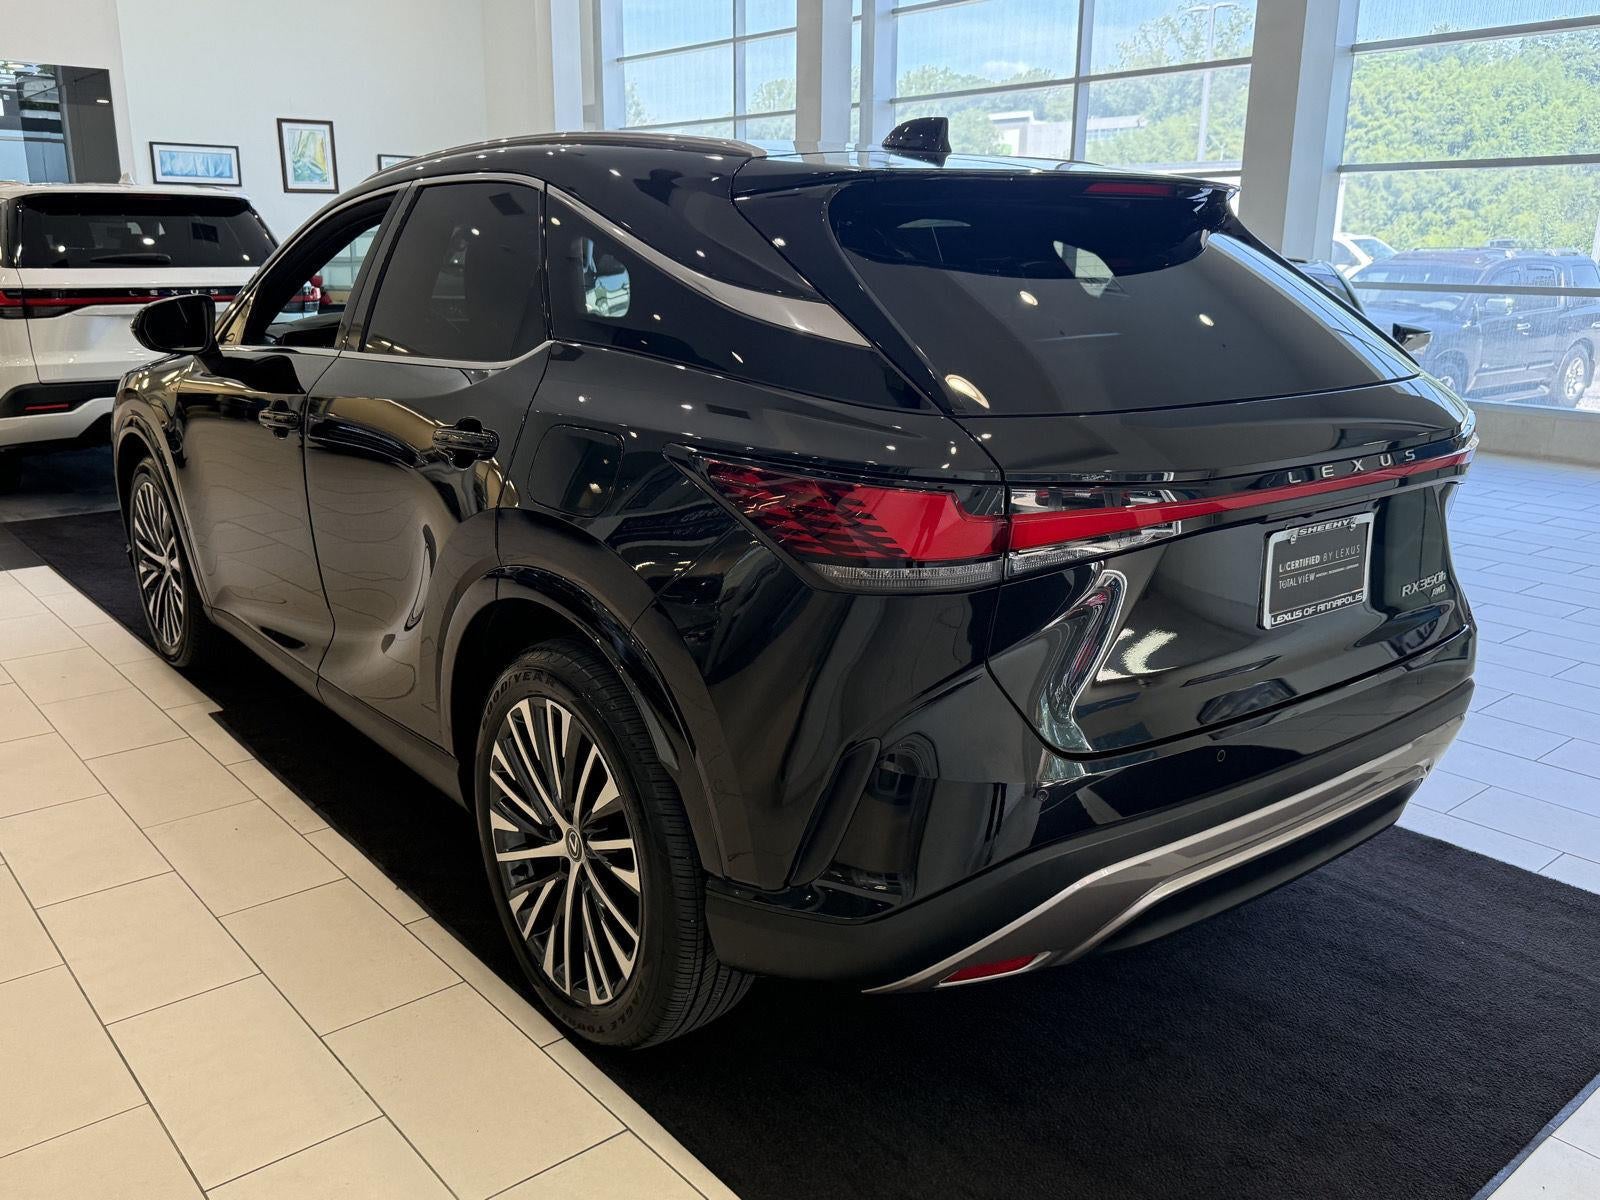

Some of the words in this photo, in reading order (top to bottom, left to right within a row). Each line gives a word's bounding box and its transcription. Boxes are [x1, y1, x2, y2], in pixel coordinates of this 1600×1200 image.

[128, 288, 219, 297] LEXUS
[1288, 449, 1416, 484] LEXUS
[1298, 519, 1351, 536] SHEEHY
[1323, 551, 1334, 562] BY
[1335, 544, 1361, 560] LEXUS
[1279, 577, 1298, 590] TOTAL
[1298, 572, 1317, 585] VIEW
[1431, 584, 1446, 597] AWD
[1271, 609, 1303, 625] LEXUS
[1303, 606, 1317, 617] OF
[1317, 592, 1364, 613] ANNAPOLIS
